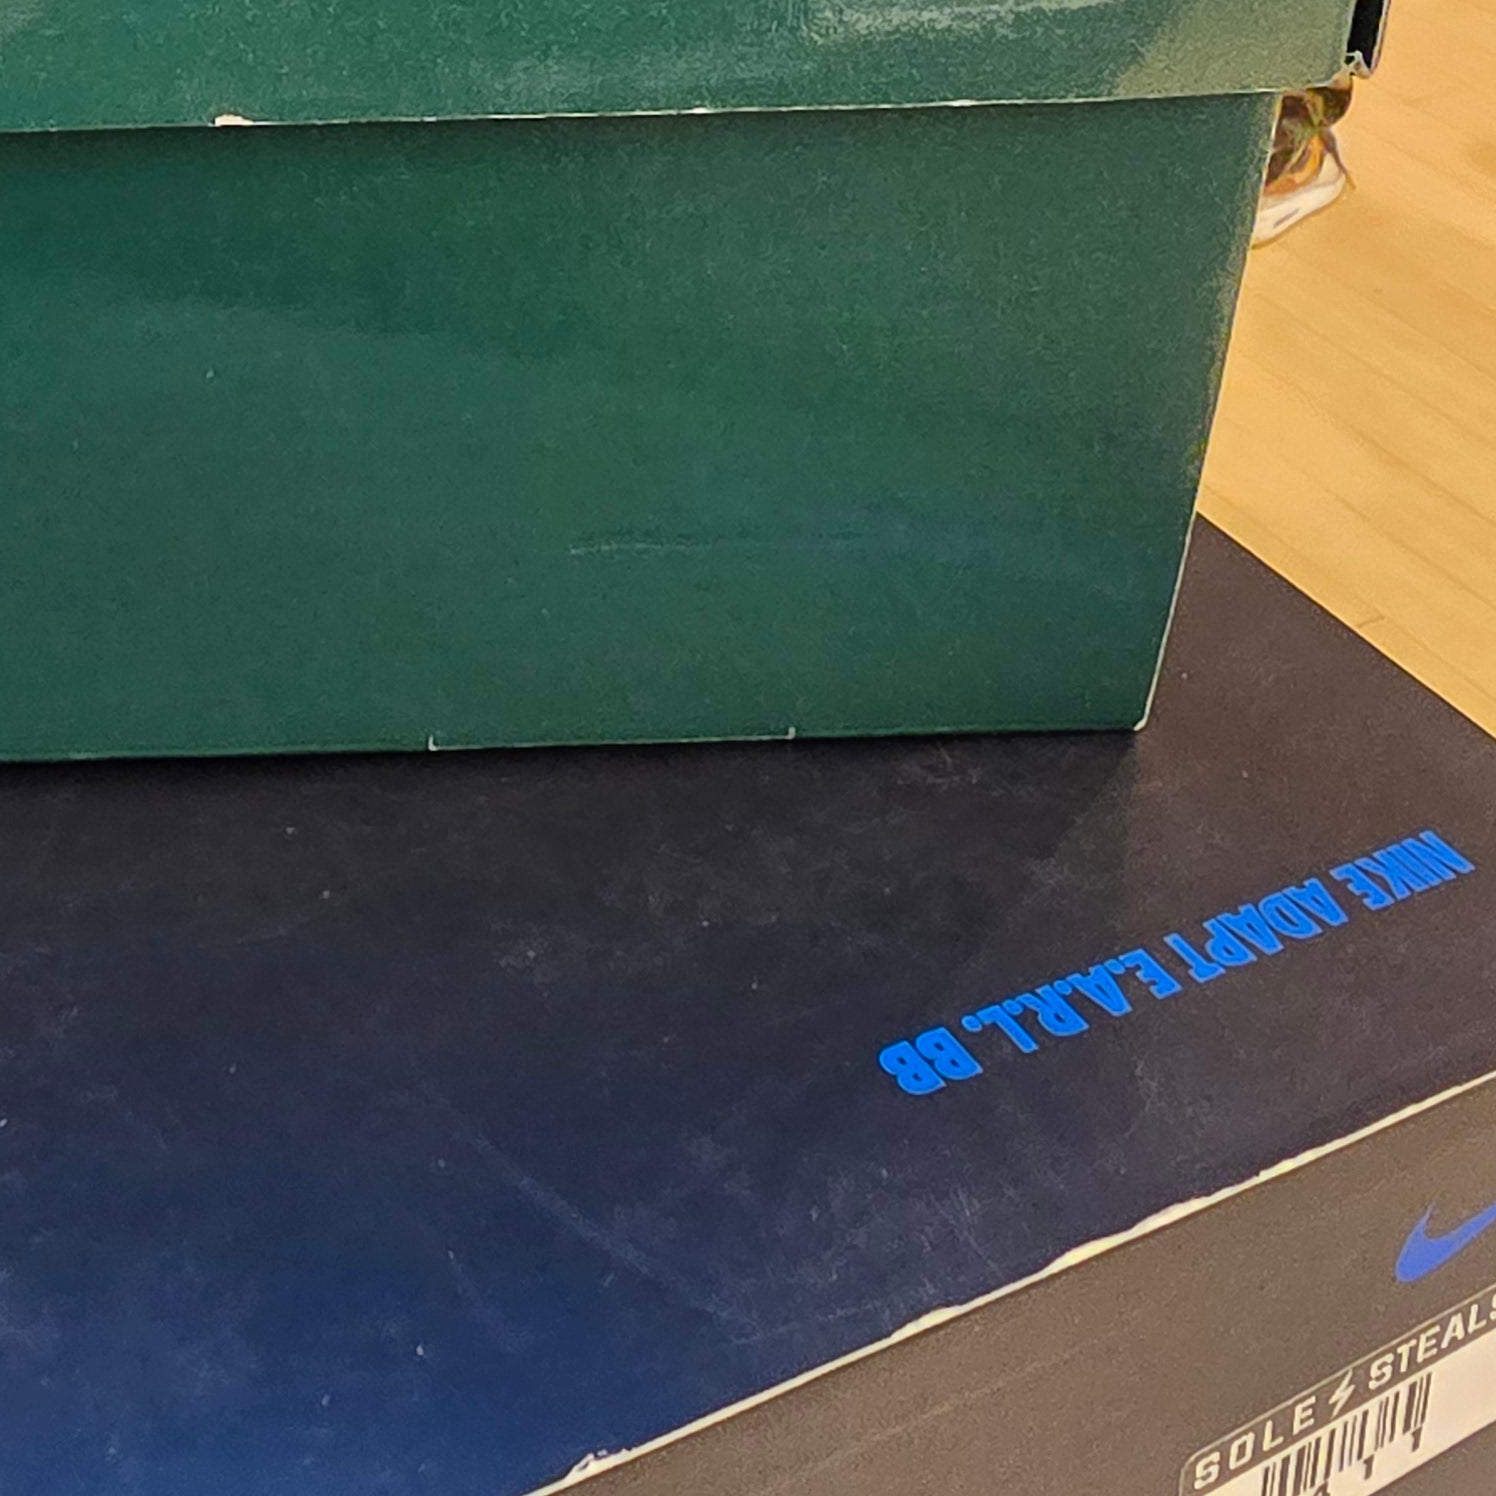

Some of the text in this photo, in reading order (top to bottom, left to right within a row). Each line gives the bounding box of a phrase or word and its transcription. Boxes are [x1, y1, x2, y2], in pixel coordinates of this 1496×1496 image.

[878, 830, 1477, 1096] NIKE ADAPT E.A.R.L. BB
[1194, 1395, 1318, 1491] SOLE
